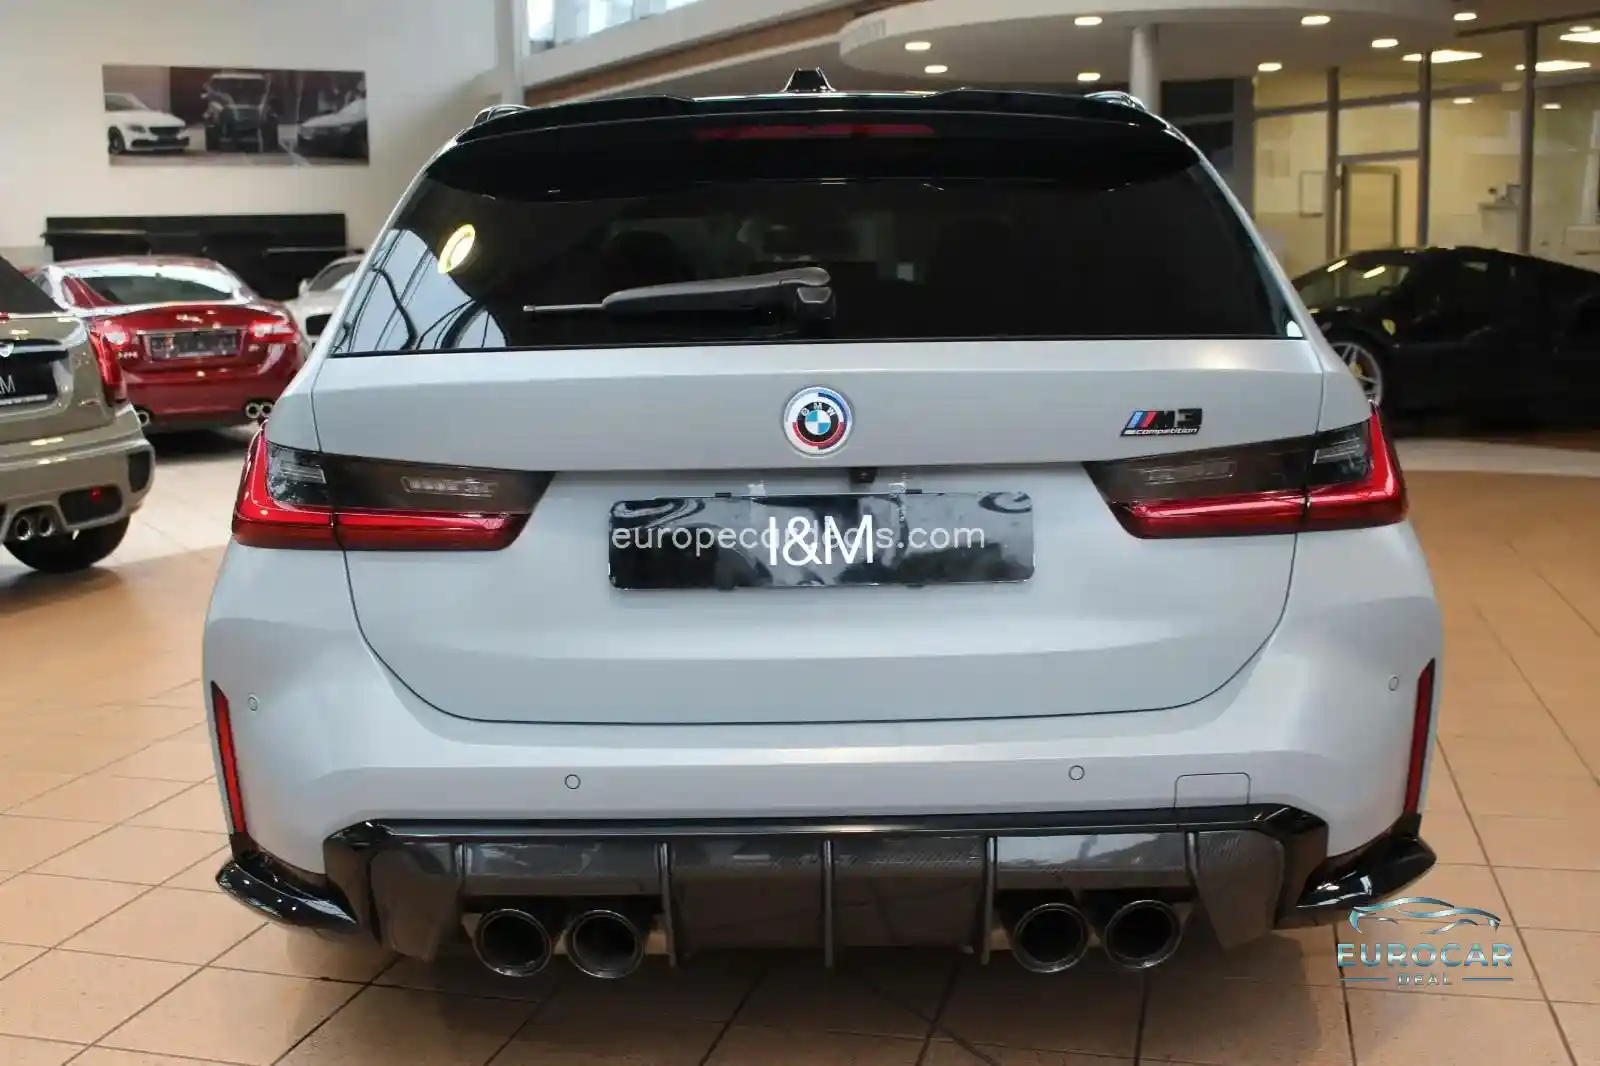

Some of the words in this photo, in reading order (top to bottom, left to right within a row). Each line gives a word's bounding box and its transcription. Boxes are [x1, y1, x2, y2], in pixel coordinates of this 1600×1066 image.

[1146, 408, 1203, 428] M3
[1136, 427, 1198, 435] competition
[769, 515, 874, 566] I&M
